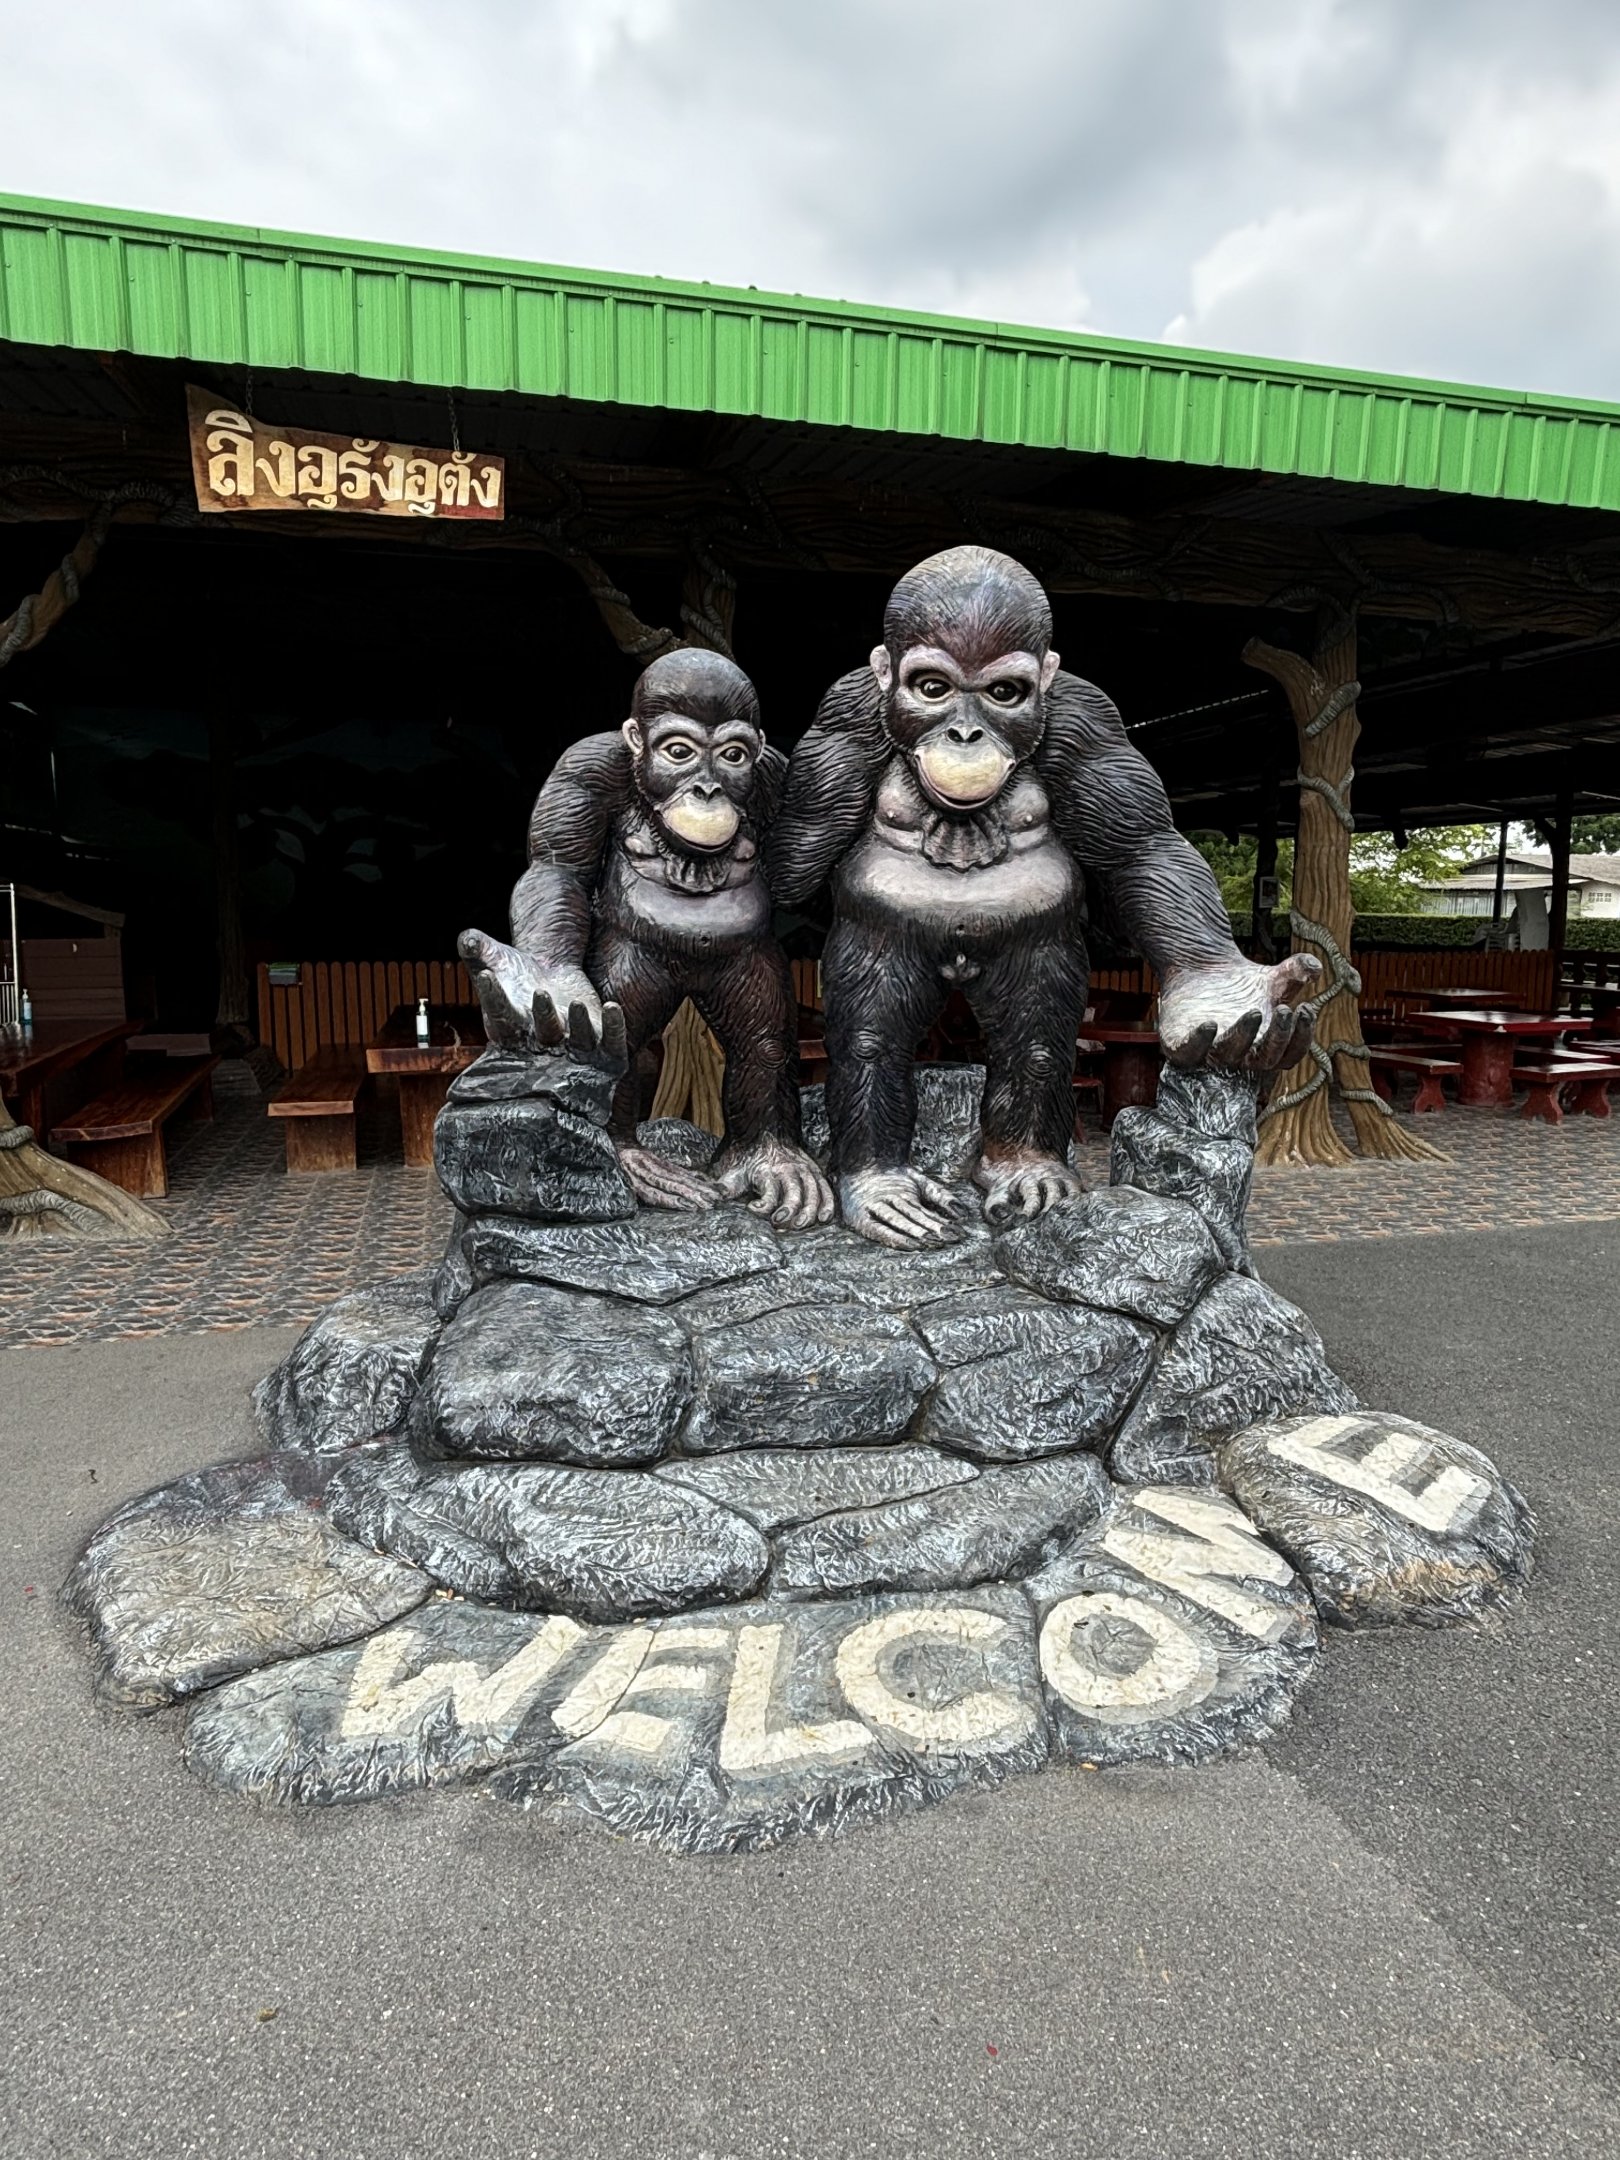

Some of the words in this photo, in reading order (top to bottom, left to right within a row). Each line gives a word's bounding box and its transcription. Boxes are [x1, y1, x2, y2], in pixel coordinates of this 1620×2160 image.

[204, 409, 501, 514] ลิงอุรังอุตัง
[340, 1412, 1490, 1770] WELCOME
